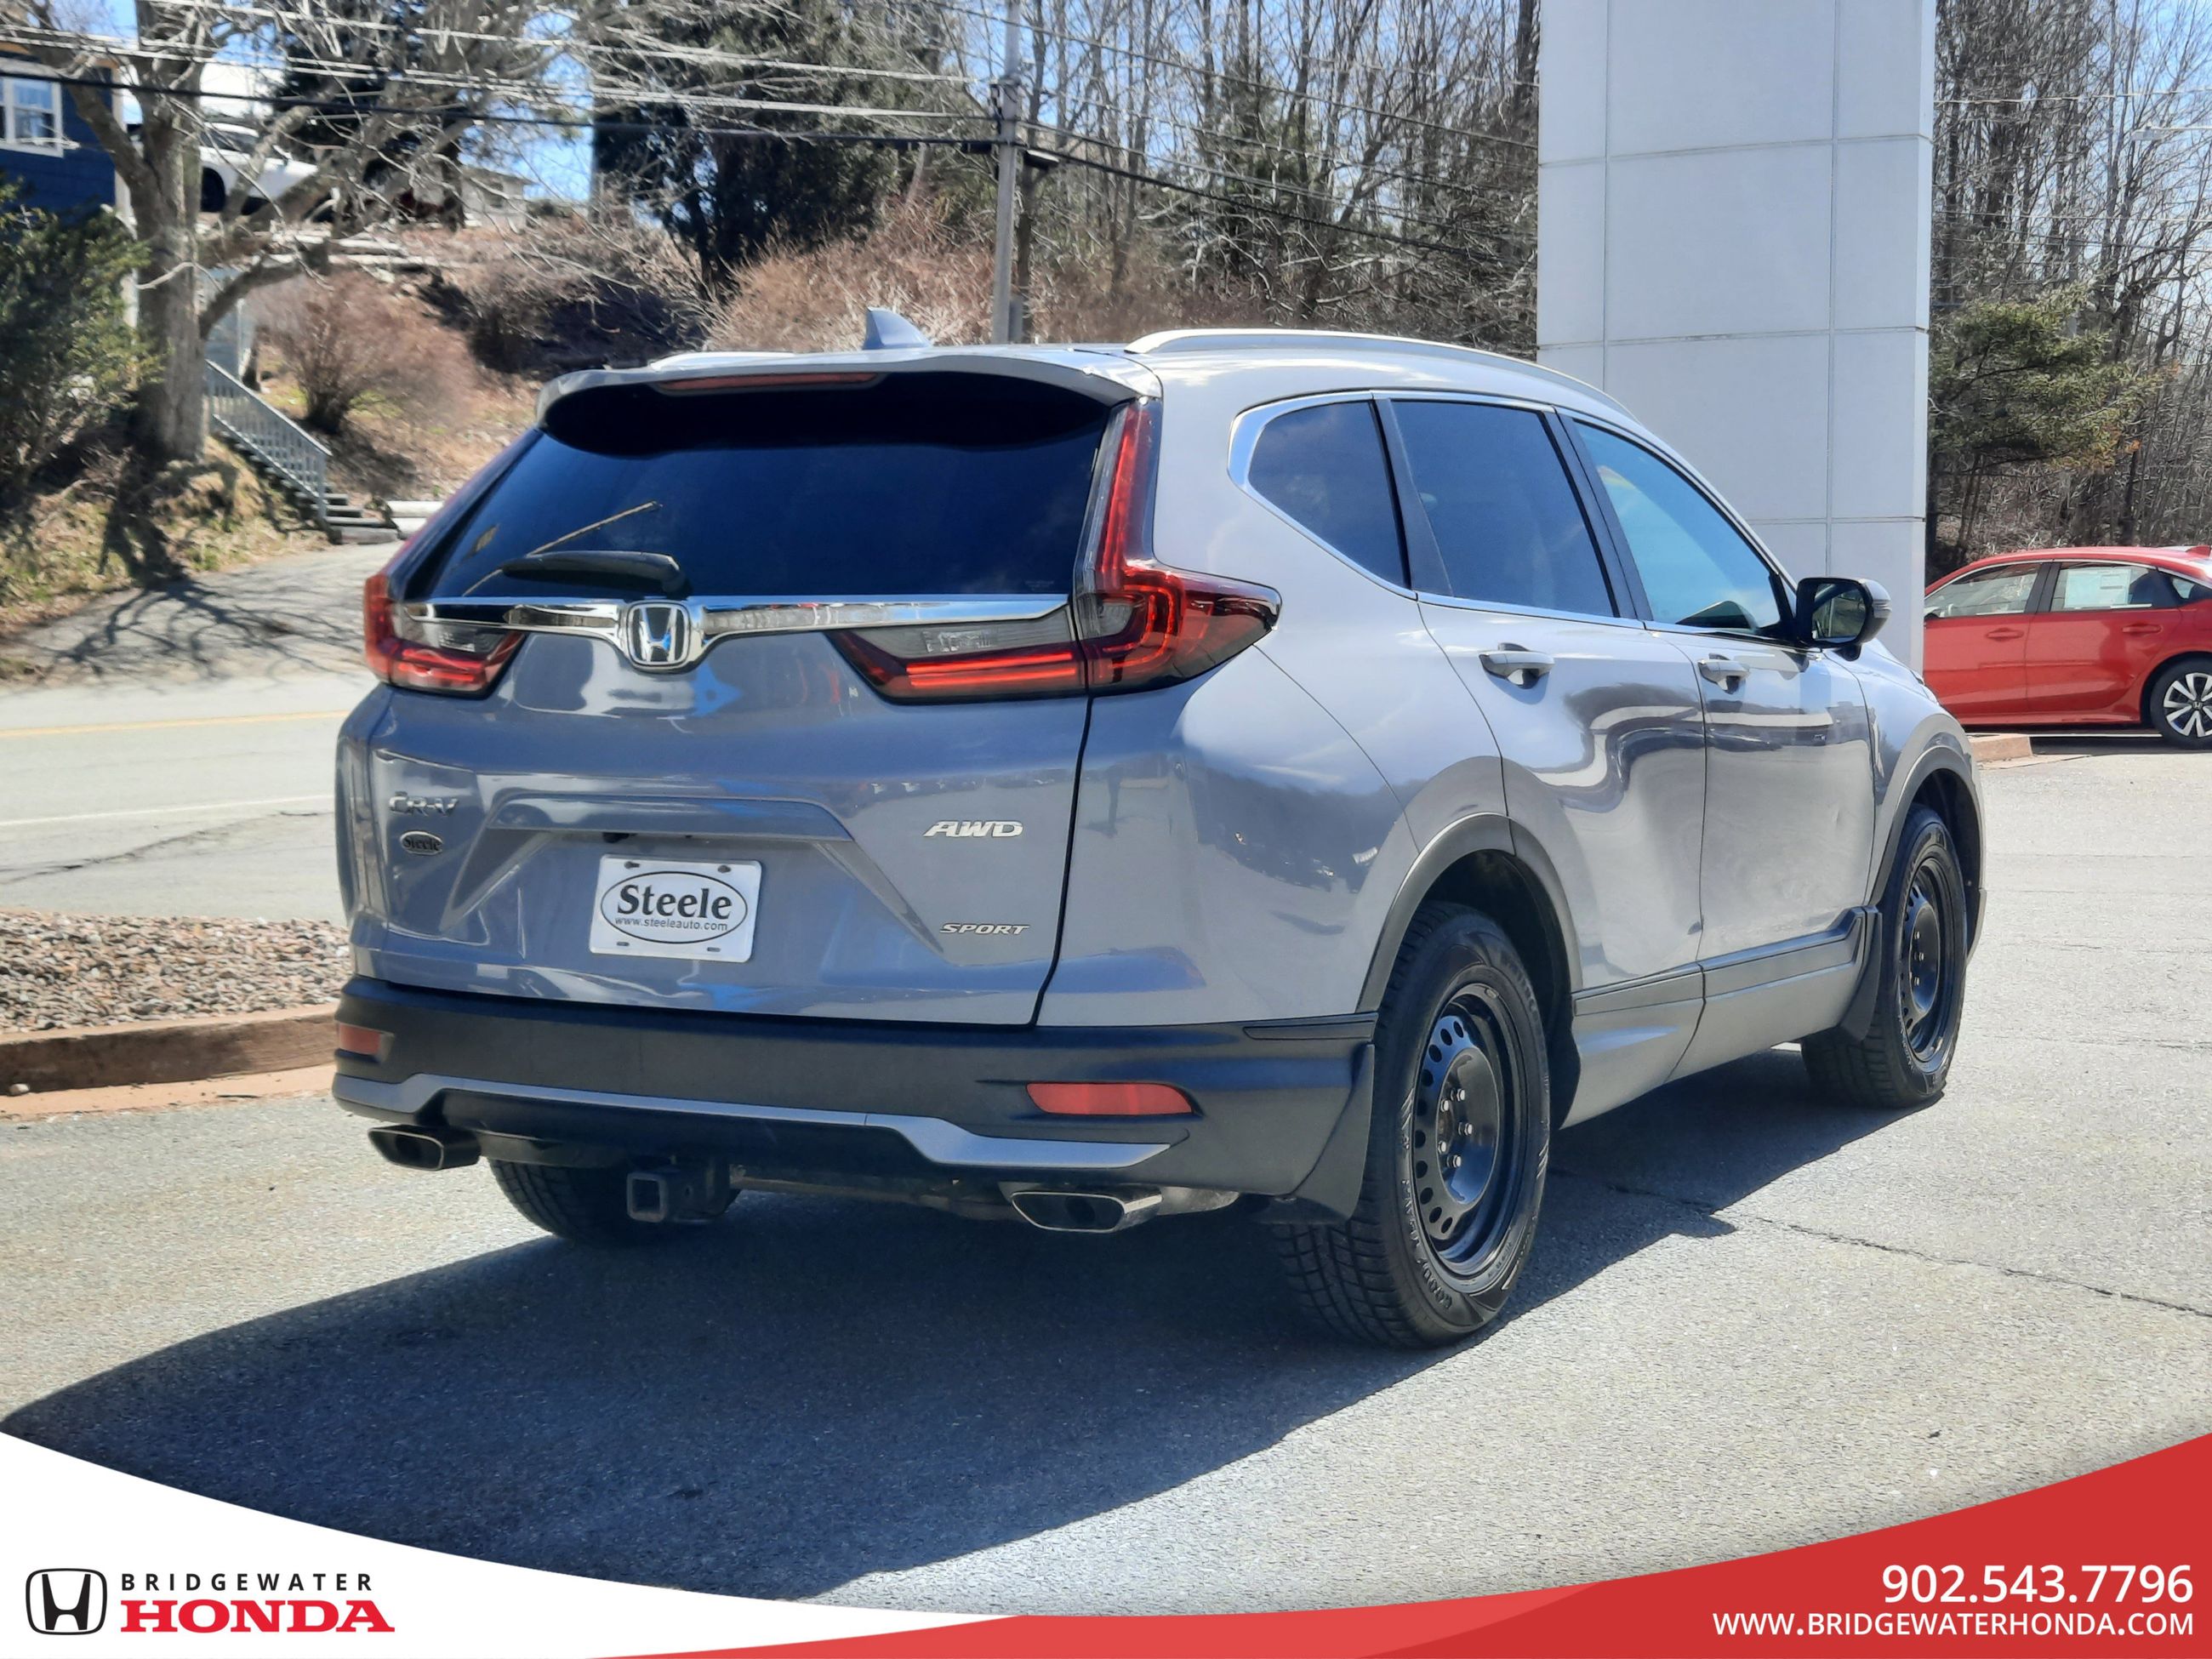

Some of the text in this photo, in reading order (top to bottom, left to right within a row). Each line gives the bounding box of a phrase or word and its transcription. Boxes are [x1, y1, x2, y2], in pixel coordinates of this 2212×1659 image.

[923, 820, 1023, 837] AWD
[617, 883, 733, 921] Steele
[615, 916, 728, 932] www.steeleauto.com
[939, 923, 1029, 934] SPORT
